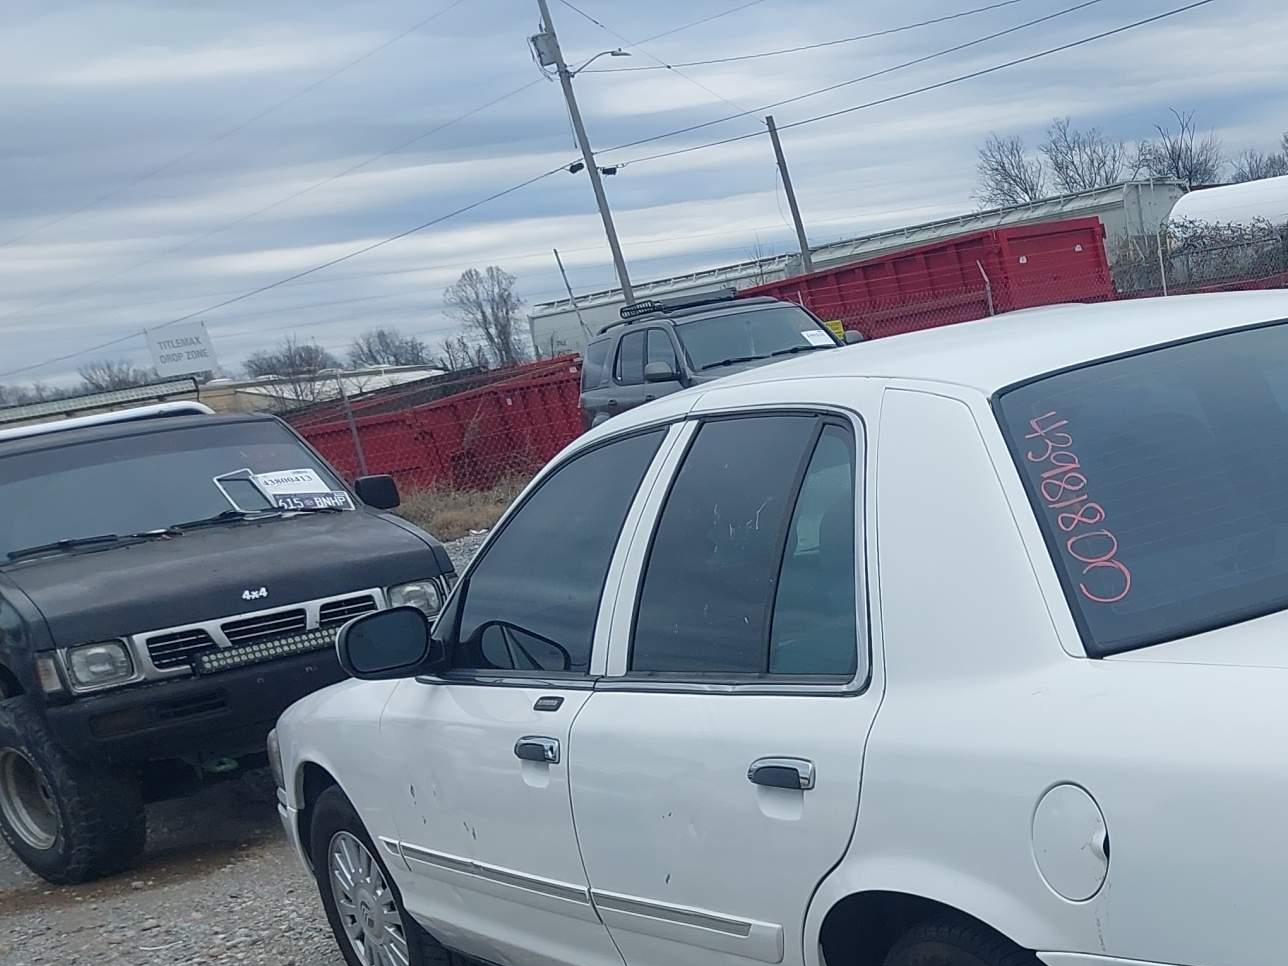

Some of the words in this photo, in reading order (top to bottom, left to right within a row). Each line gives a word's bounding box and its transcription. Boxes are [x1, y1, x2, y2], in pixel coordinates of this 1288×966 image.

[157, 336, 202, 350] TITLEMAX
[159, 352, 183, 364] DROP
[184, 348, 209, 360] ZONE
[1025, 411, 1131, 602] 43981800
[241, 586, 268, 600] 4x4
